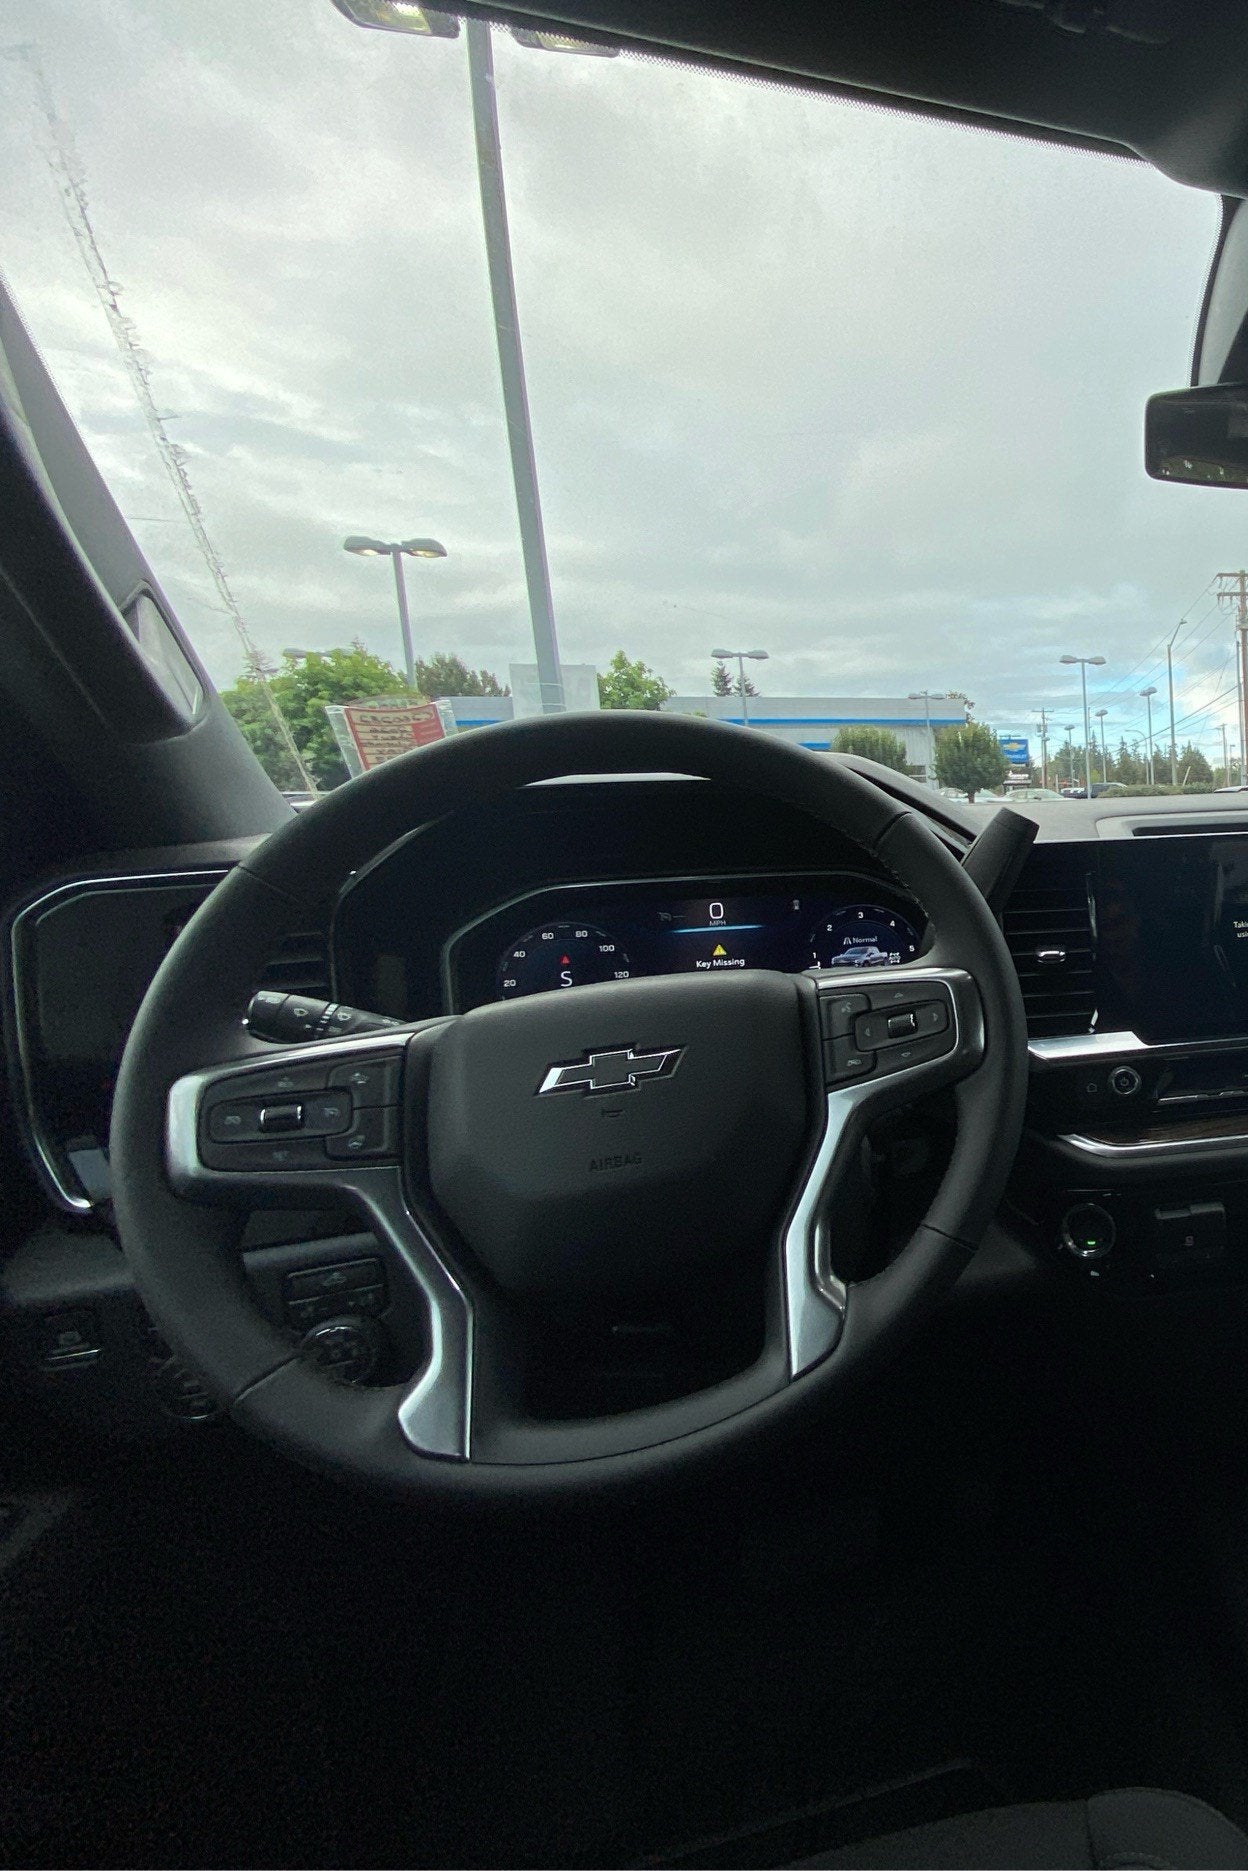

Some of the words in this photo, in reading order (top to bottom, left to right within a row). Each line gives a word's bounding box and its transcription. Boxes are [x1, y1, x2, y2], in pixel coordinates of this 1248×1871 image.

[709, 902, 724, 919] 0
[857, 911, 864, 919] 3
[826, 924, 833, 932] 2
[541, 932, 554, 940] 60
[575, 930, 588, 938] 80
[852, 936, 878, 944] Normal
[599, 944, 615, 952] 100
[513, 950, 526, 958] 40
[696, 960, 711, 969] Key
[713, 958, 745, 967] Missing
[560, 970, 573, 987] S
[503, 979, 516, 988] 20
[589, 1153, 642, 1172] AIRBAG
